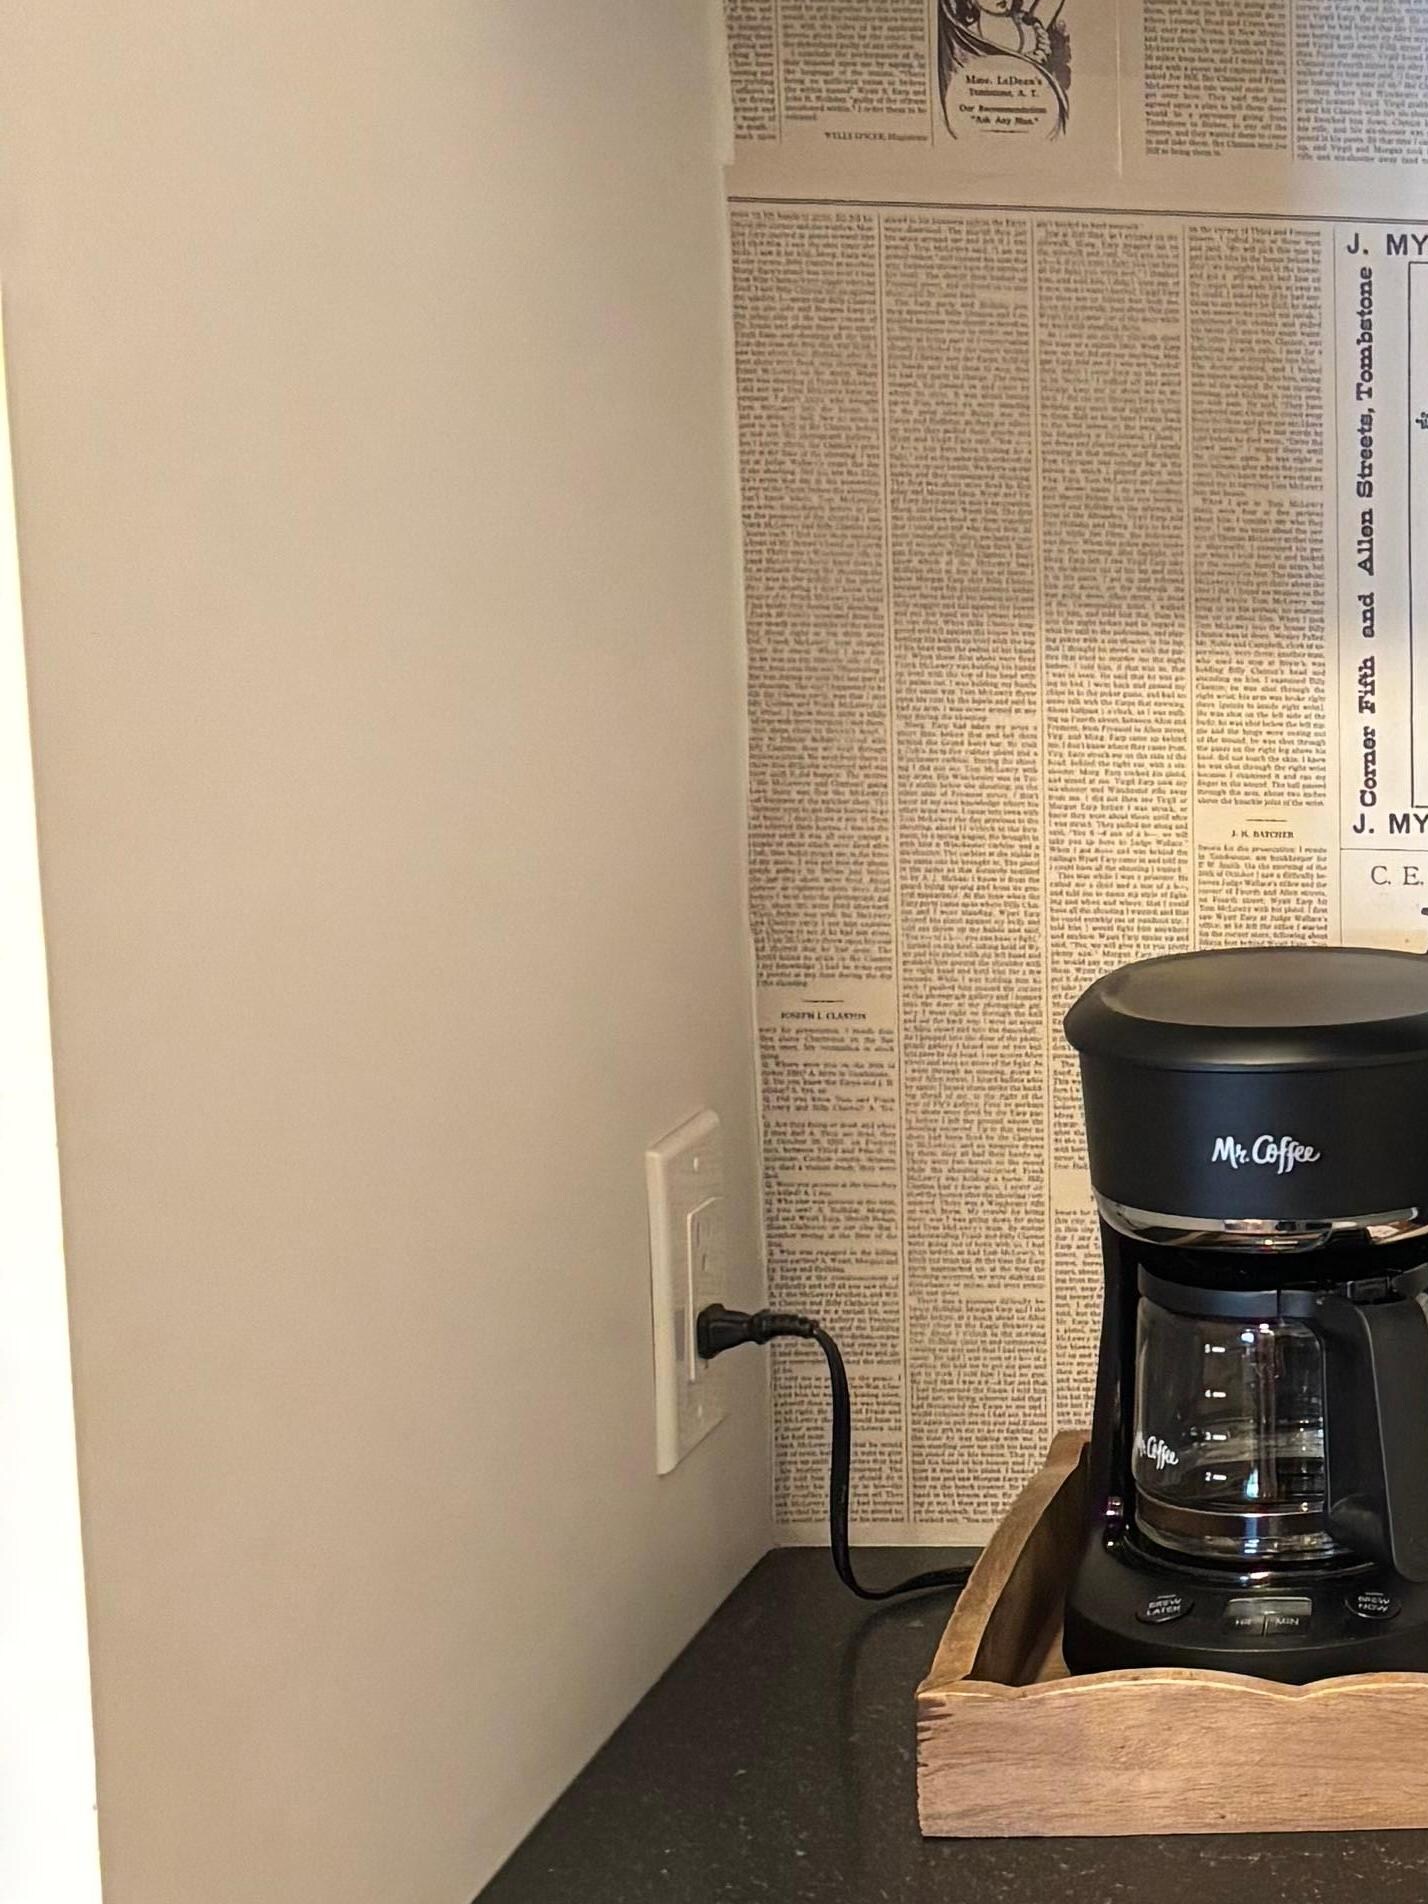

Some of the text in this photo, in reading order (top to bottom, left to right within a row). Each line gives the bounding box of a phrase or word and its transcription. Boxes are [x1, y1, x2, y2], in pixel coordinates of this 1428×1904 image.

[1347, 233, 1369, 256] J.
[1356, 266, 1378, 807] Corner Fifth and Allen Streets, Tombstone
[1353, 815, 1374, 834] J.
[1370, 866, 1389, 884] C.
[1403, 867, 1423, 885] E.
[1212, 1136, 1320, 1174] Mr. Coffee
